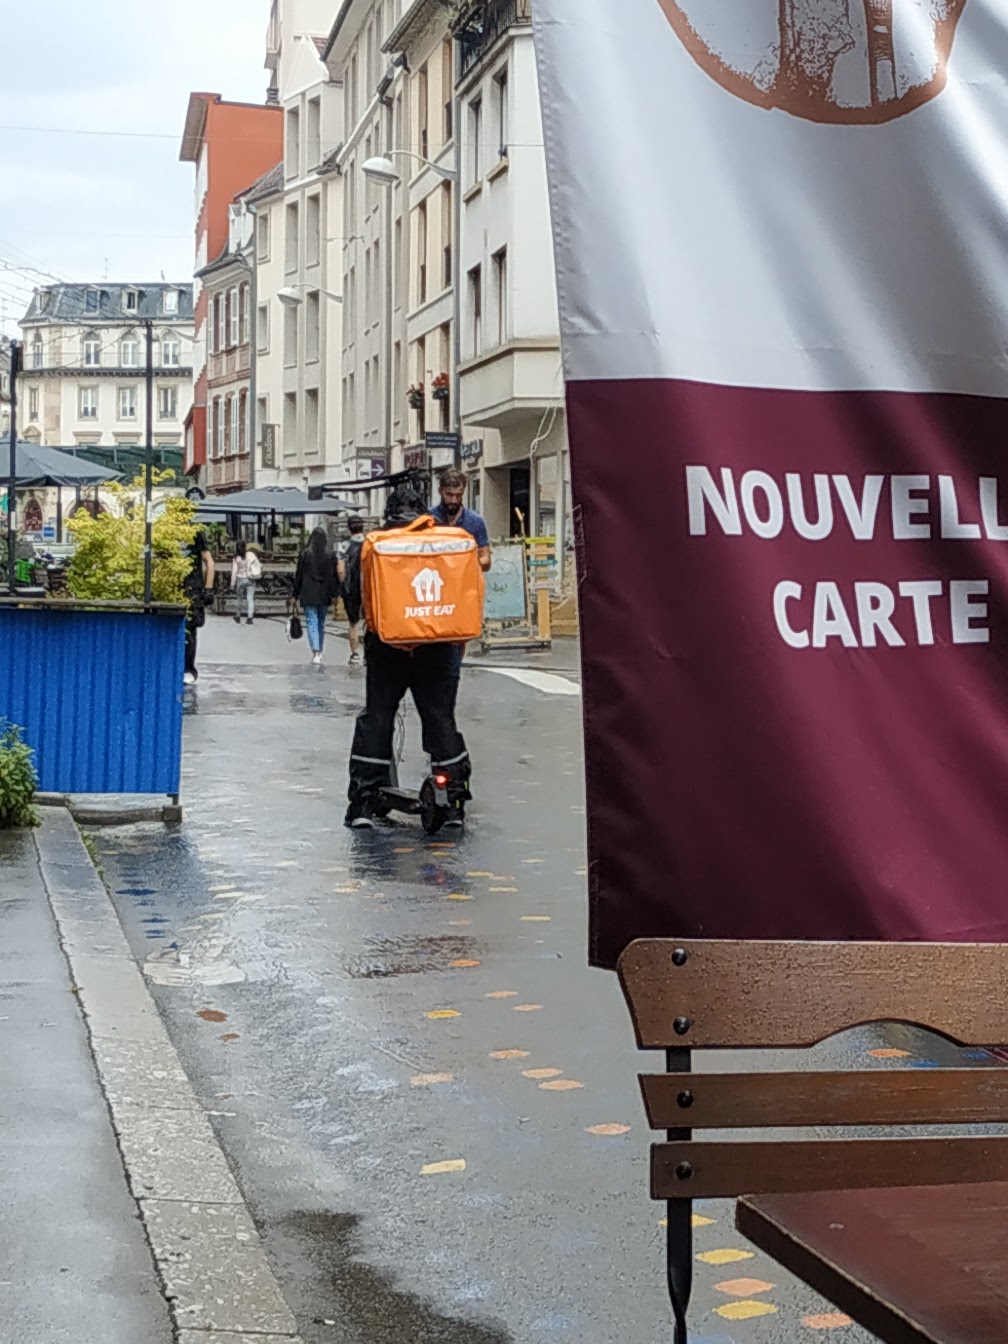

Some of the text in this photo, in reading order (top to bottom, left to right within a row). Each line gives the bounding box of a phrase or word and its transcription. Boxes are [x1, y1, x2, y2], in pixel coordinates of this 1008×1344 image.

[404, 604, 456, 618] JUST EAT
[773, 579, 990, 648] CARTE
